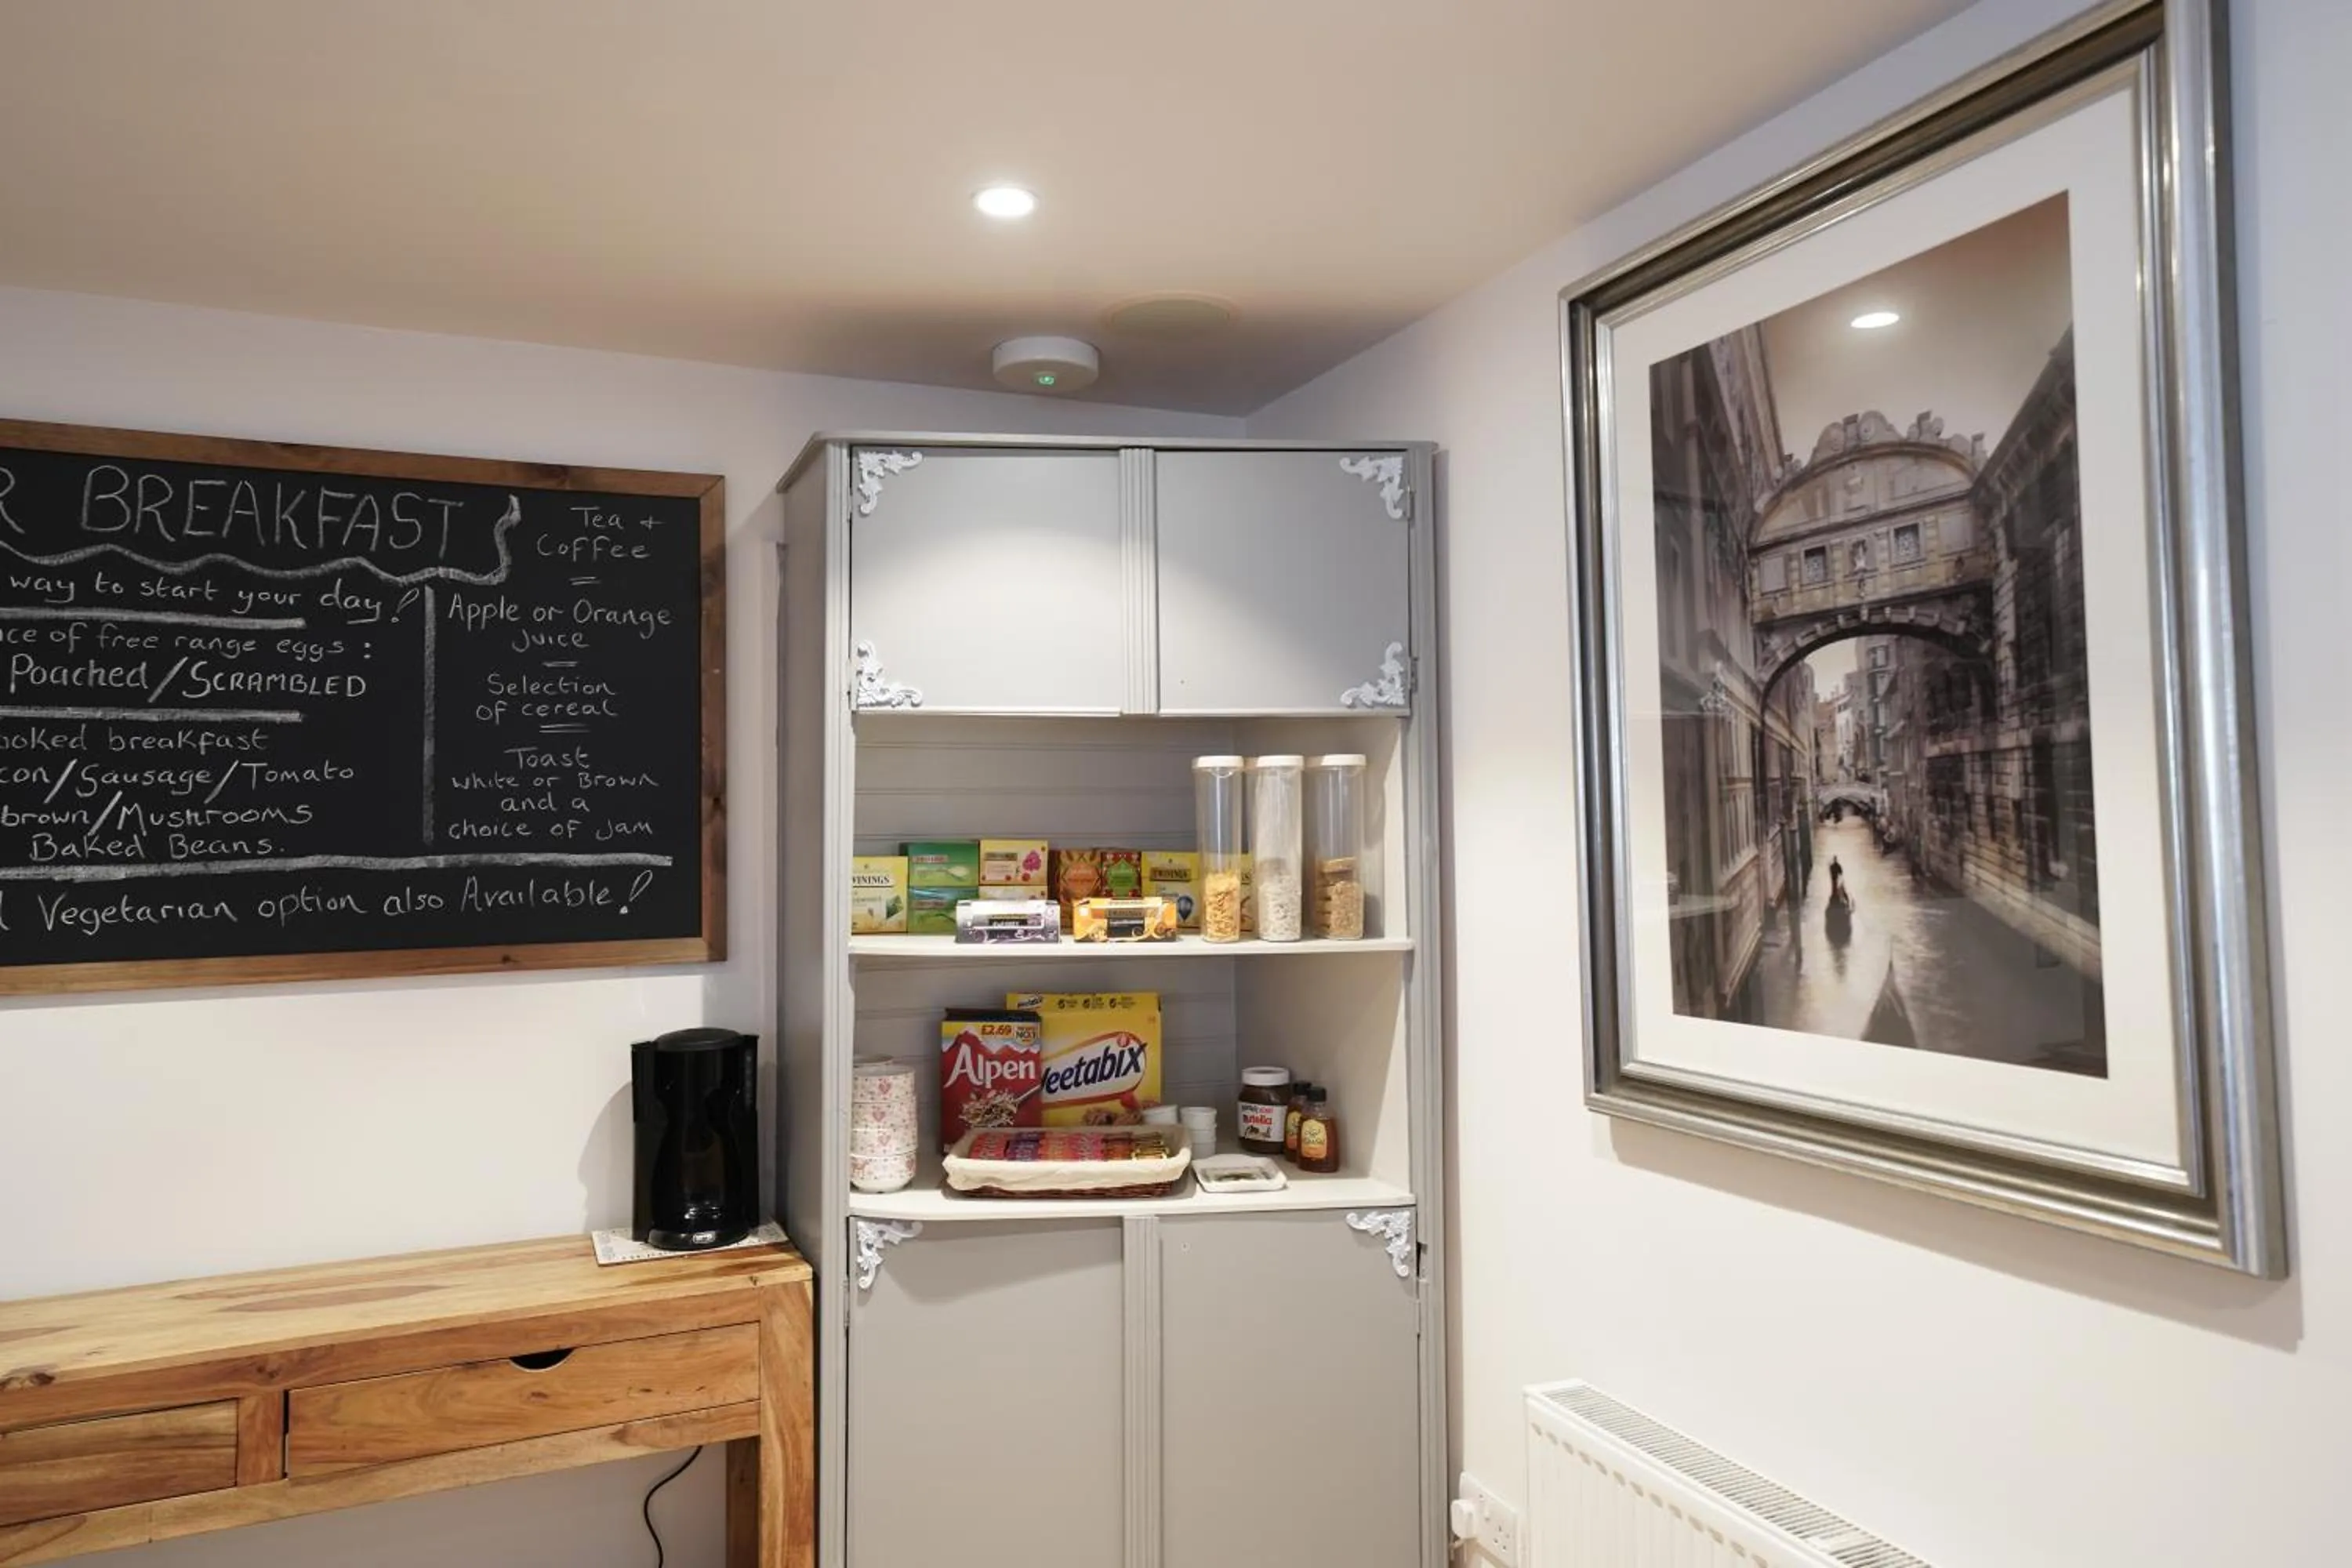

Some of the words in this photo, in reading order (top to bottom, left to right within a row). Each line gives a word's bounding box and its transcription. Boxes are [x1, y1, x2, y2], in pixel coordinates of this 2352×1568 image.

[82, 465, 464, 559] BREAKFAST
[571, 506, 623, 529] Tea
[9, 575, 75, 603] way
[96, 572, 123, 593] to
[141, 577, 217, 601] start
[231, 590, 302, 614] your
[448, 593, 521, 631] Apple
[533, 607, 563, 622] or
[573, 598, 672, 640] Orange
[50, 622, 87, 652] of
[99, 623, 158, 648] free
[175, 635, 256, 659] range
[488, 673, 615, 695] Selection
[522, 699, 617, 717] cereal
[505, 746, 590, 769] Toast
[452, 771, 519, 789] white
[533, 777, 559, 787] or
[578, 772, 658, 789] Brown
[501, 792, 557, 811] and
[572, 798, 590, 811] a
[449, 818, 532, 839] choice
[30, 833, 144, 861] Baked
[38, 894, 237, 935] Vegetarian
[258, 886, 367, 926] option
[383, 887, 443, 916] also
[943, 1043, 1036, 1089] Alpen
